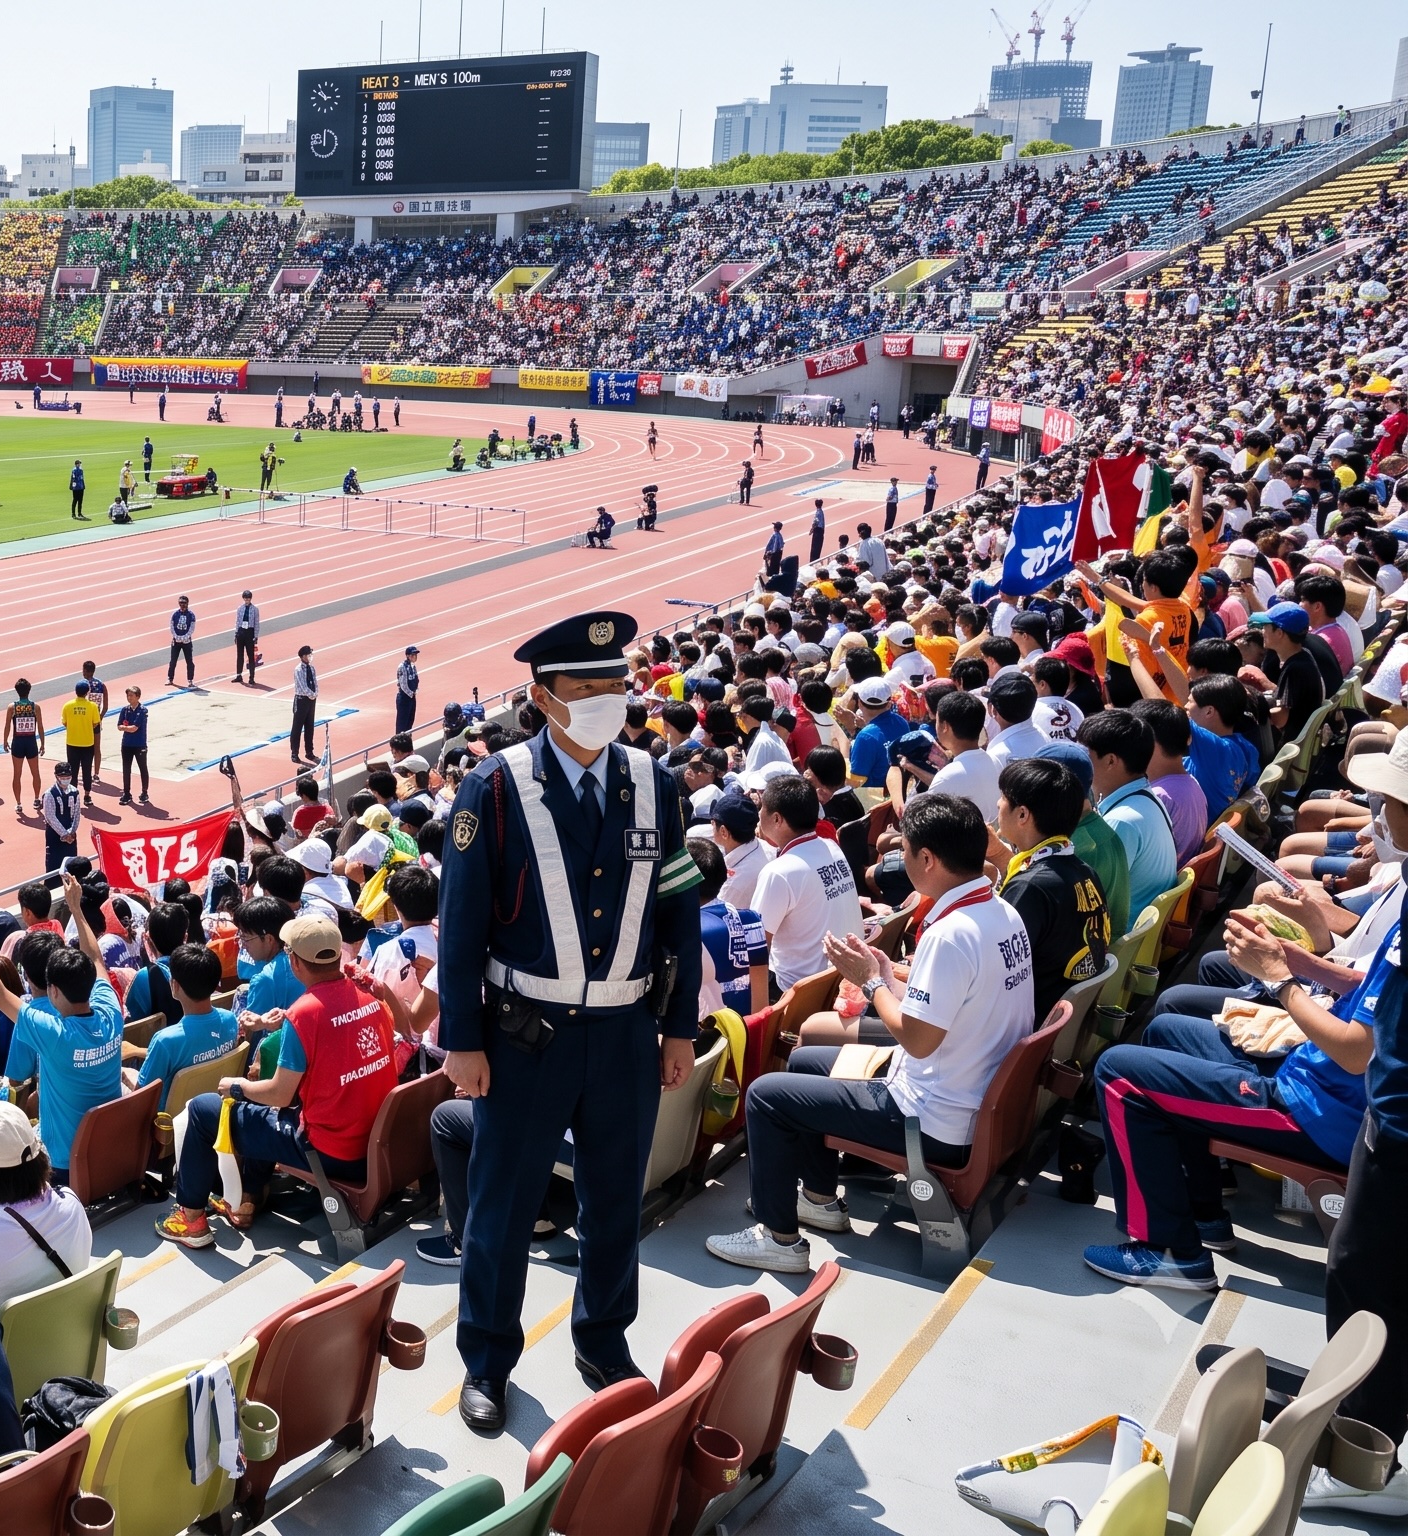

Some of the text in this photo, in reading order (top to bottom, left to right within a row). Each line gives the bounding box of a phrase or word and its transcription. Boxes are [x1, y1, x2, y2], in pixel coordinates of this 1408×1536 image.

[362, 76, 389, 89] HEAT
[392, 75, 399, 87] 3
[414, 73, 447, 86] MEN'S
[453, 71, 480, 84] 100m
[363, 103, 367, 112] 1
[362, 114, 368, 124] 2
[362, 126, 367, 135] 3
